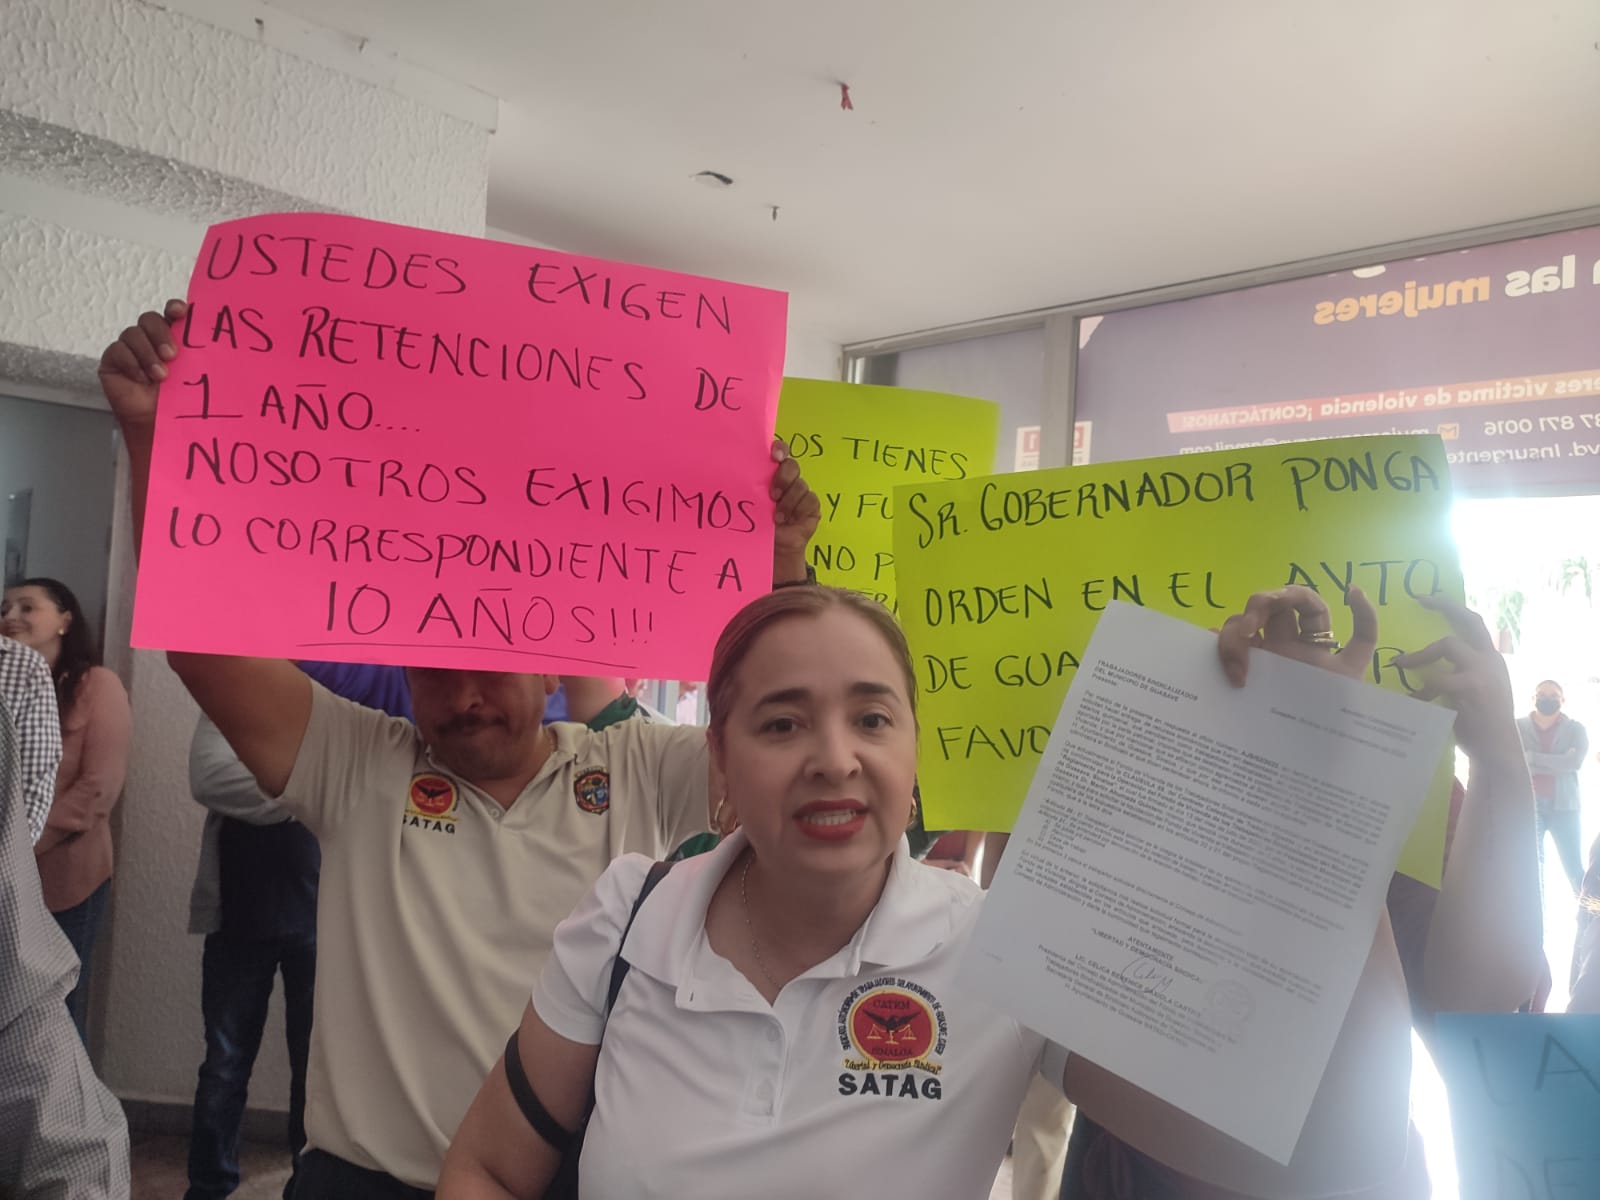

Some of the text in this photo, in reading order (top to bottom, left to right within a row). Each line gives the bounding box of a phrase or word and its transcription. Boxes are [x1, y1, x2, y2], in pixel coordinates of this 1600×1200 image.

[207, 234, 731, 334] USTEDES EXIGEN
[182, 303, 743, 412] LAS RETENCIONES DE
[175, 373, 244, 420] 1
[841, 436, 968, 481] TIENES
[186, 436, 756, 534] NOSOTROS EXIGIMOS
[826, 492, 894, 523] Y FU
[980, 461, 1255, 532] GOBERNADOR
[1281, 451, 1440, 512] PONGA
[246, 514, 697, 596] CORRESPONDIENTE
[715, 558, 743, 593] A
[813, 544, 856, 571] NO
[326, 580, 391, 634] 10
[925, 577, 1054, 626] ORDEN
[1081, 574, 1145, 613] EN
[922, 651, 973, 694] DE
[994, 650, 1080, 688] GUA
[936, 720, 1052, 762] FAVO
[838, 1072, 942, 1101] SATAG
